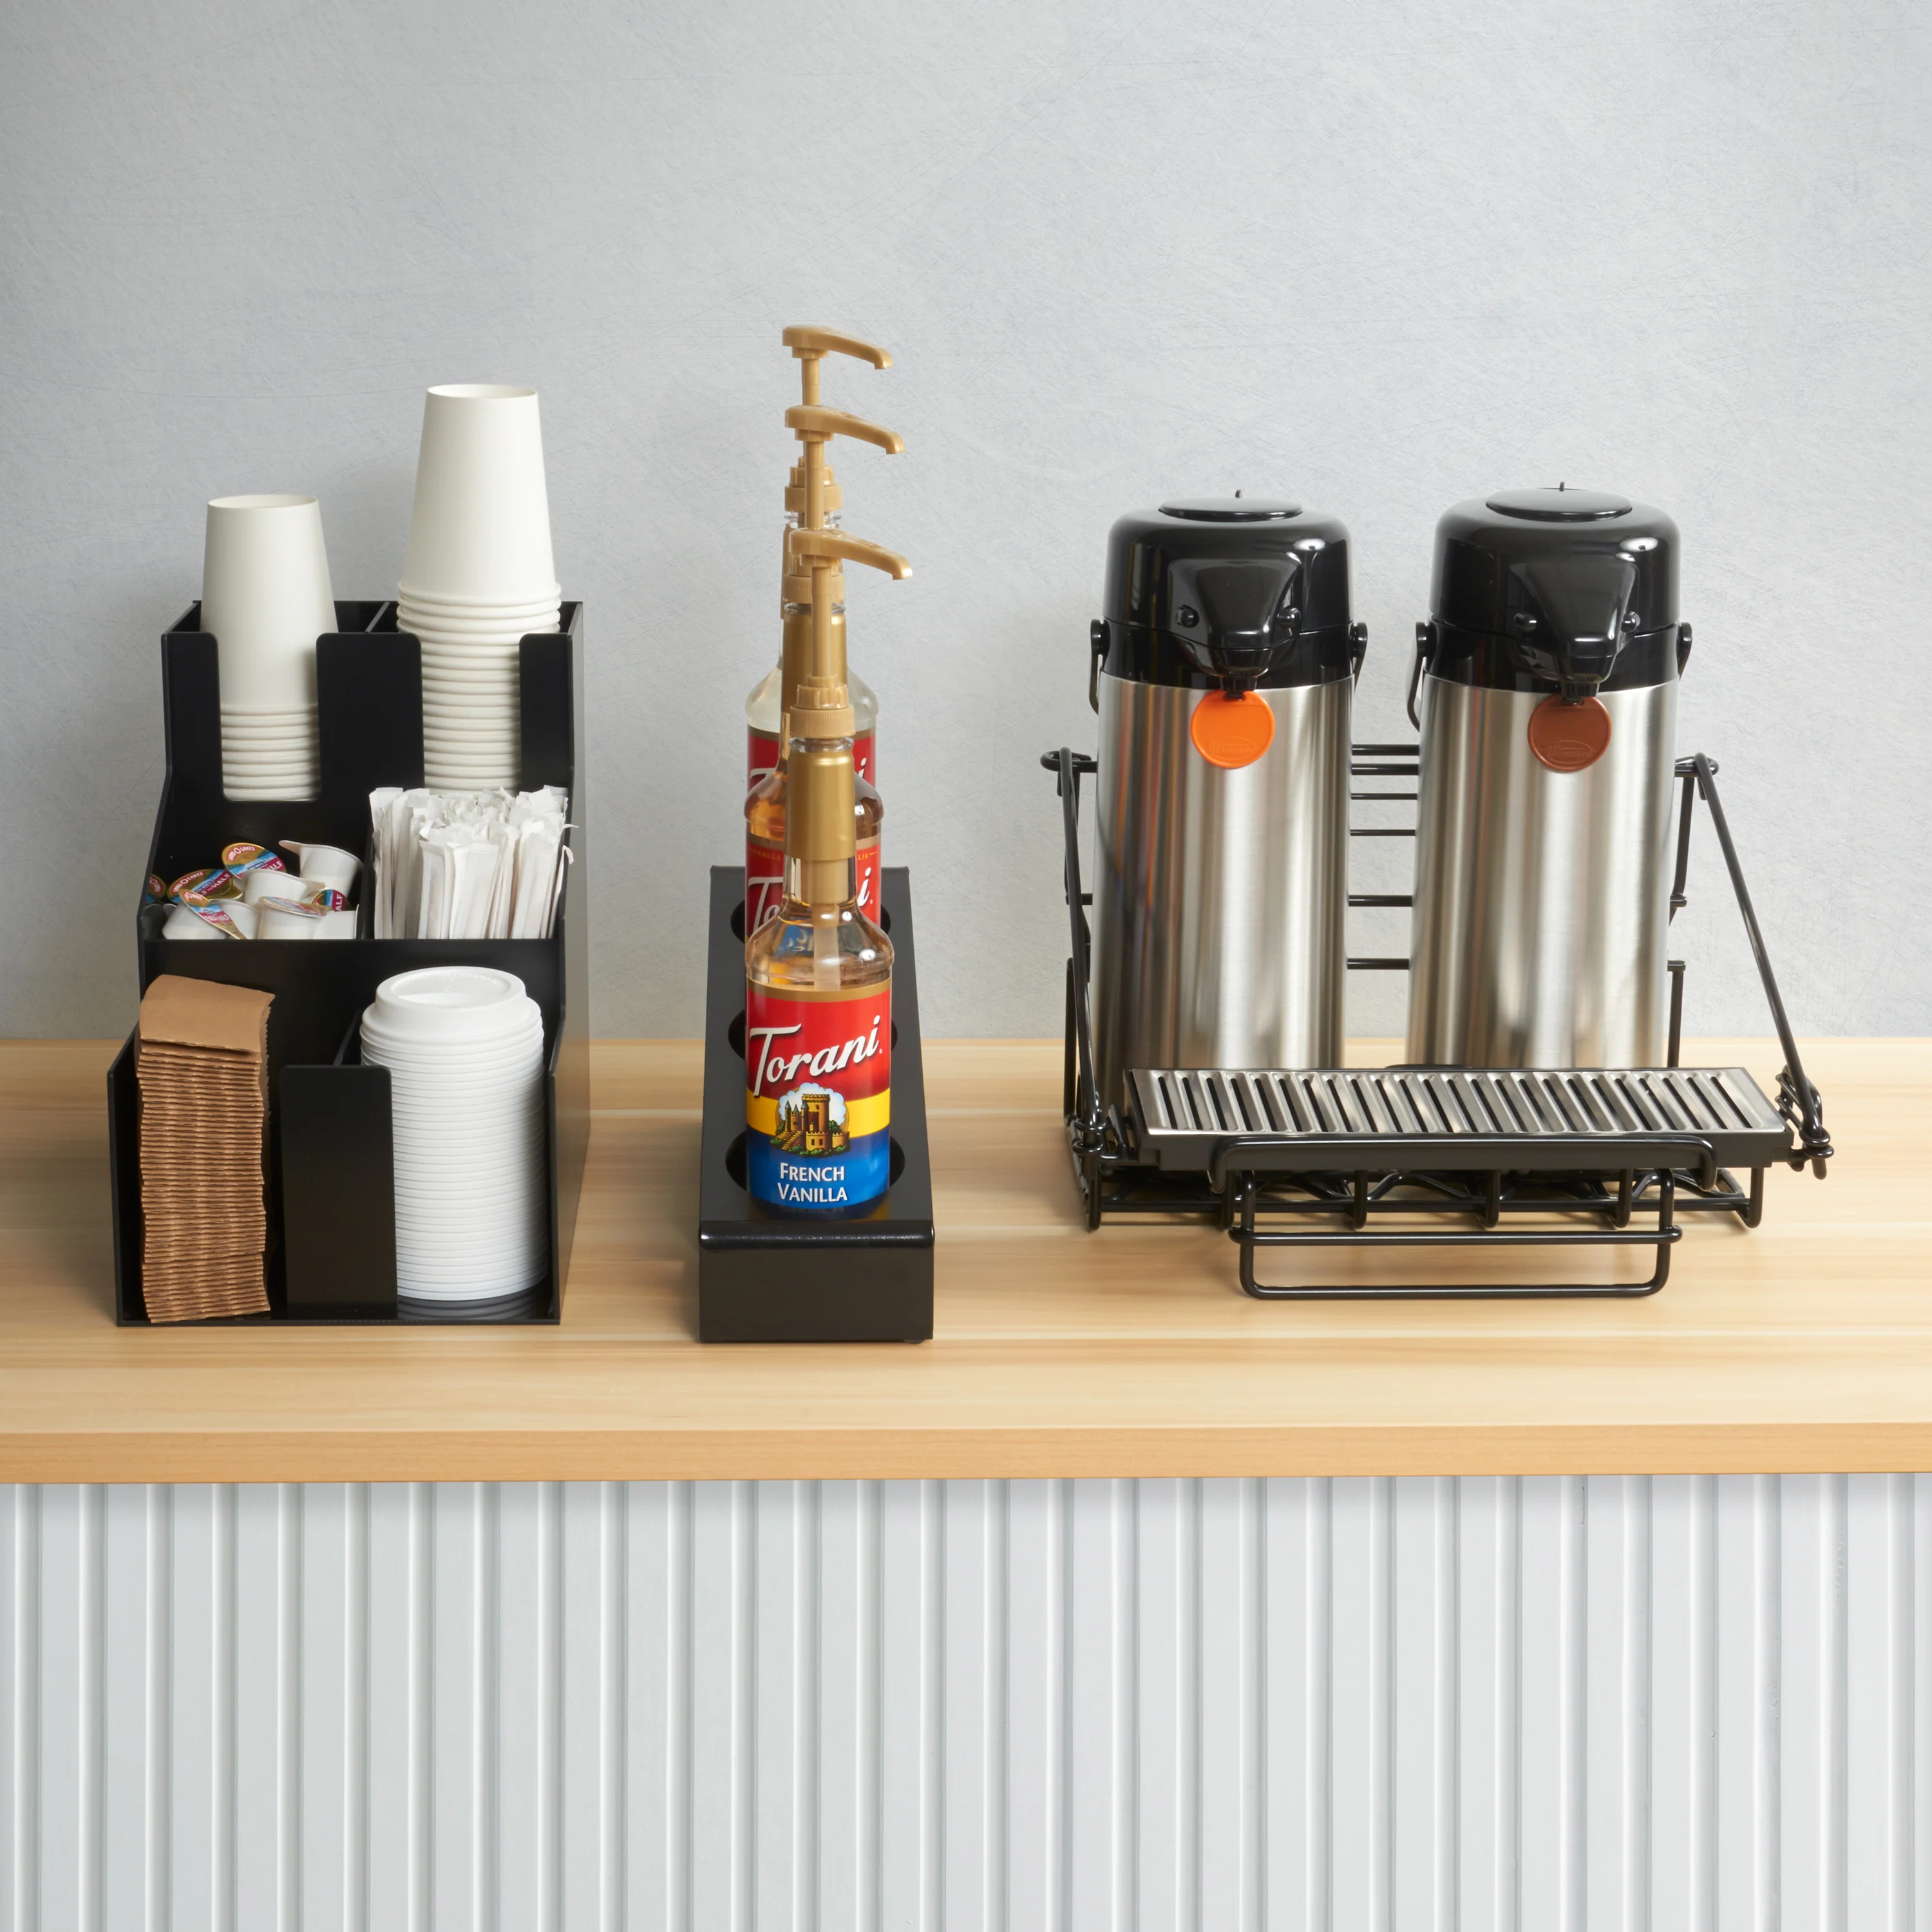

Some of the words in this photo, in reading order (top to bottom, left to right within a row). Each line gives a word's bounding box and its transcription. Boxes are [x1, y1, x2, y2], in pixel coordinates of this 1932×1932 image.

[335, 893, 343, 912] ALF
[749, 1015, 880, 1097] Torani
[780, 1162, 845, 1182] FRENCH
[777, 1182, 848, 1203] VANILLA
